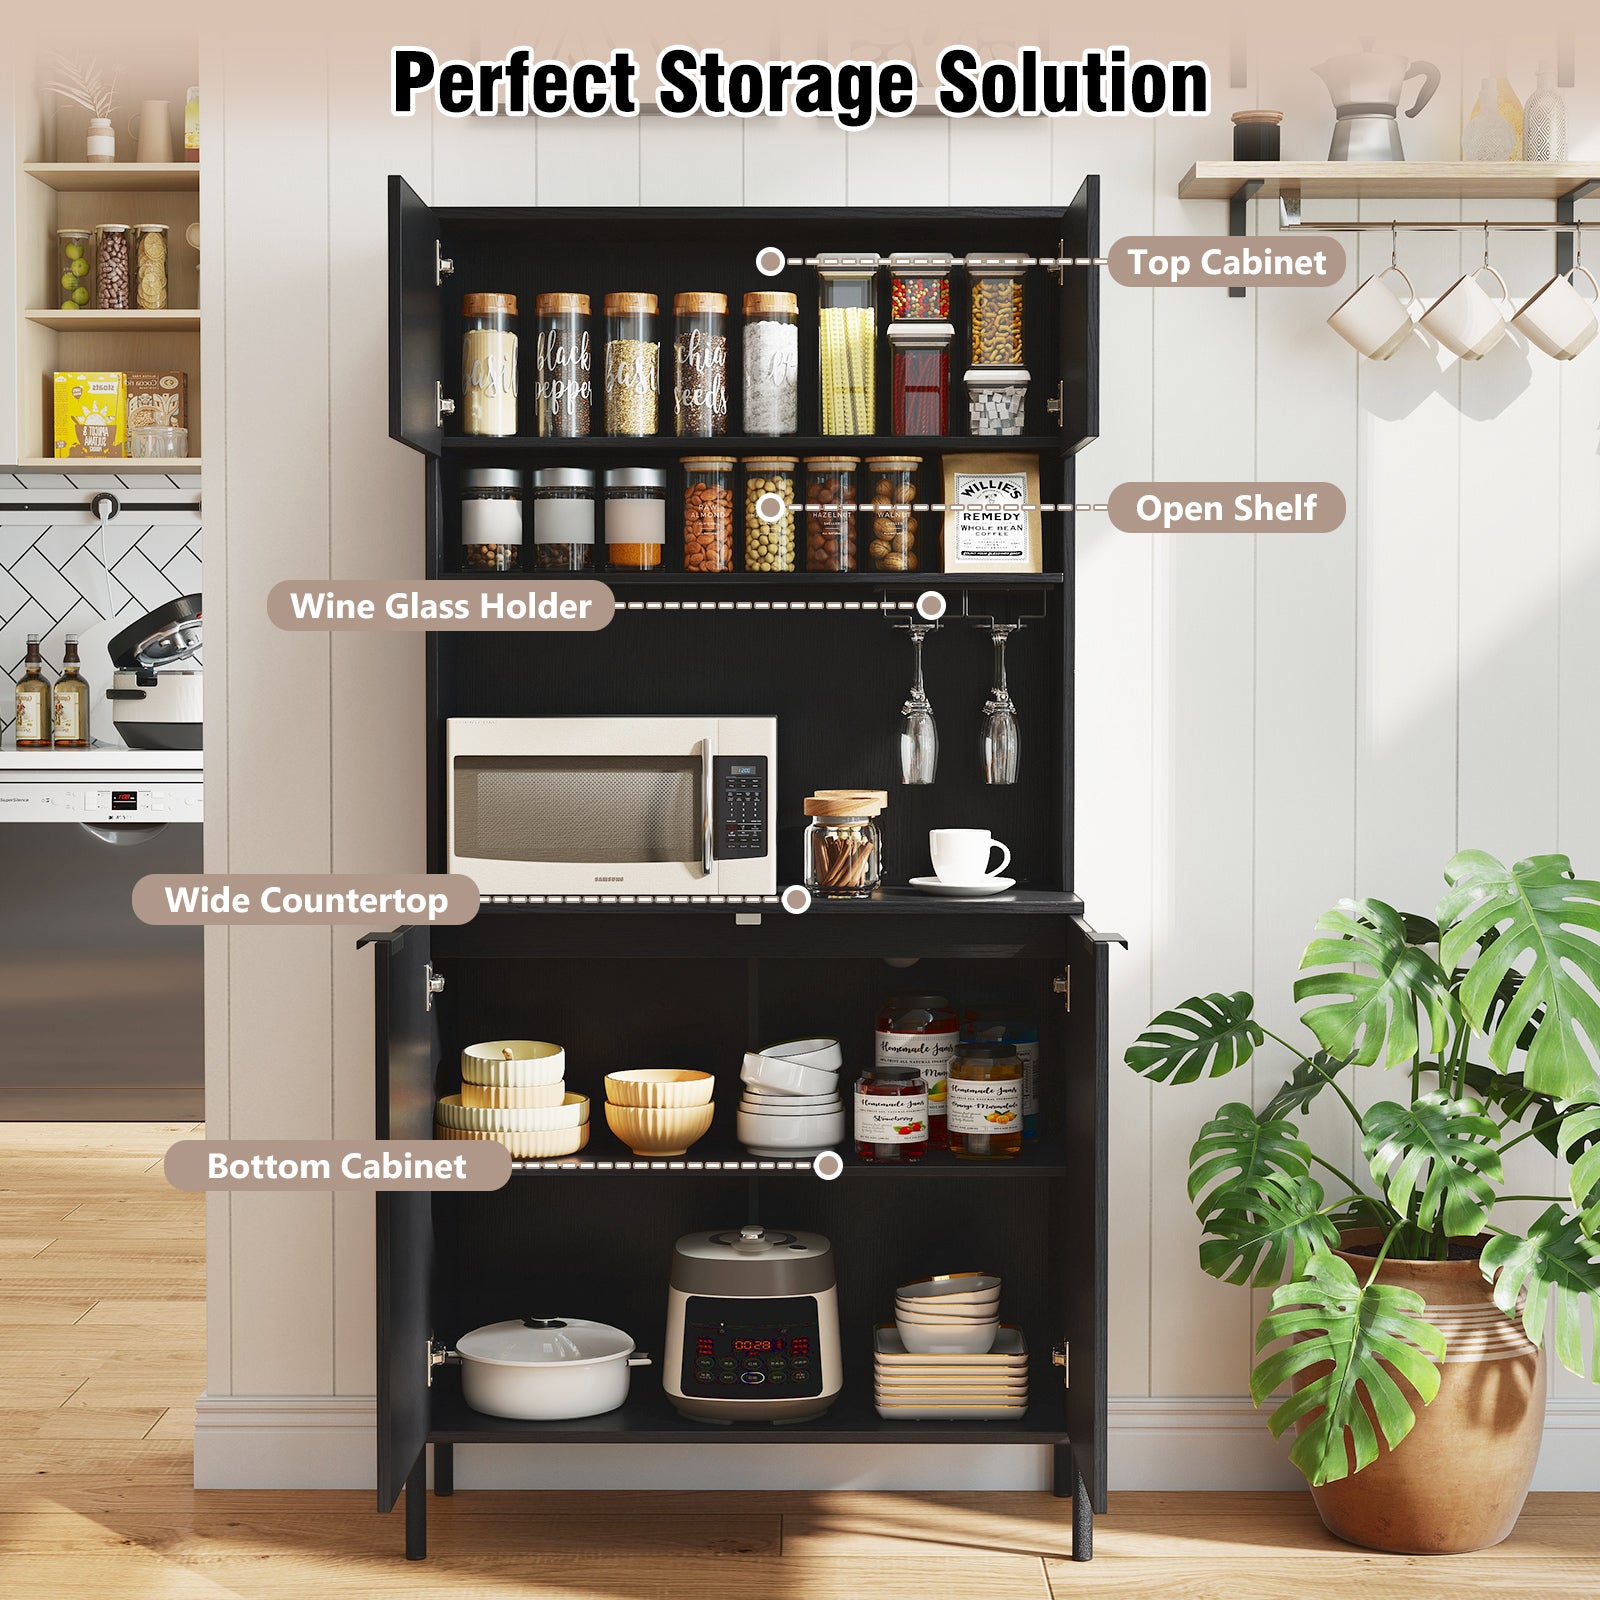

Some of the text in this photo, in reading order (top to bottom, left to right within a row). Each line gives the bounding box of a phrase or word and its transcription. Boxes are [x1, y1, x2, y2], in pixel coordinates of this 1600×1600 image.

[536, 329, 591, 372] black
[677, 328, 727, 373] chia
[674, 373, 729, 415] seeds
[960, 479, 1023, 500] WILLIE'S
[690, 511, 726, 519] ALMOND
[963, 512, 1021, 521] REMEDY
[960, 524, 1023, 532] WHOLE BEAN
[880, 1041, 954, 1056] Homemade Jams
[951, 1084, 995, 1095] Homemade
[861, 1098, 905, 1107] Homemade
